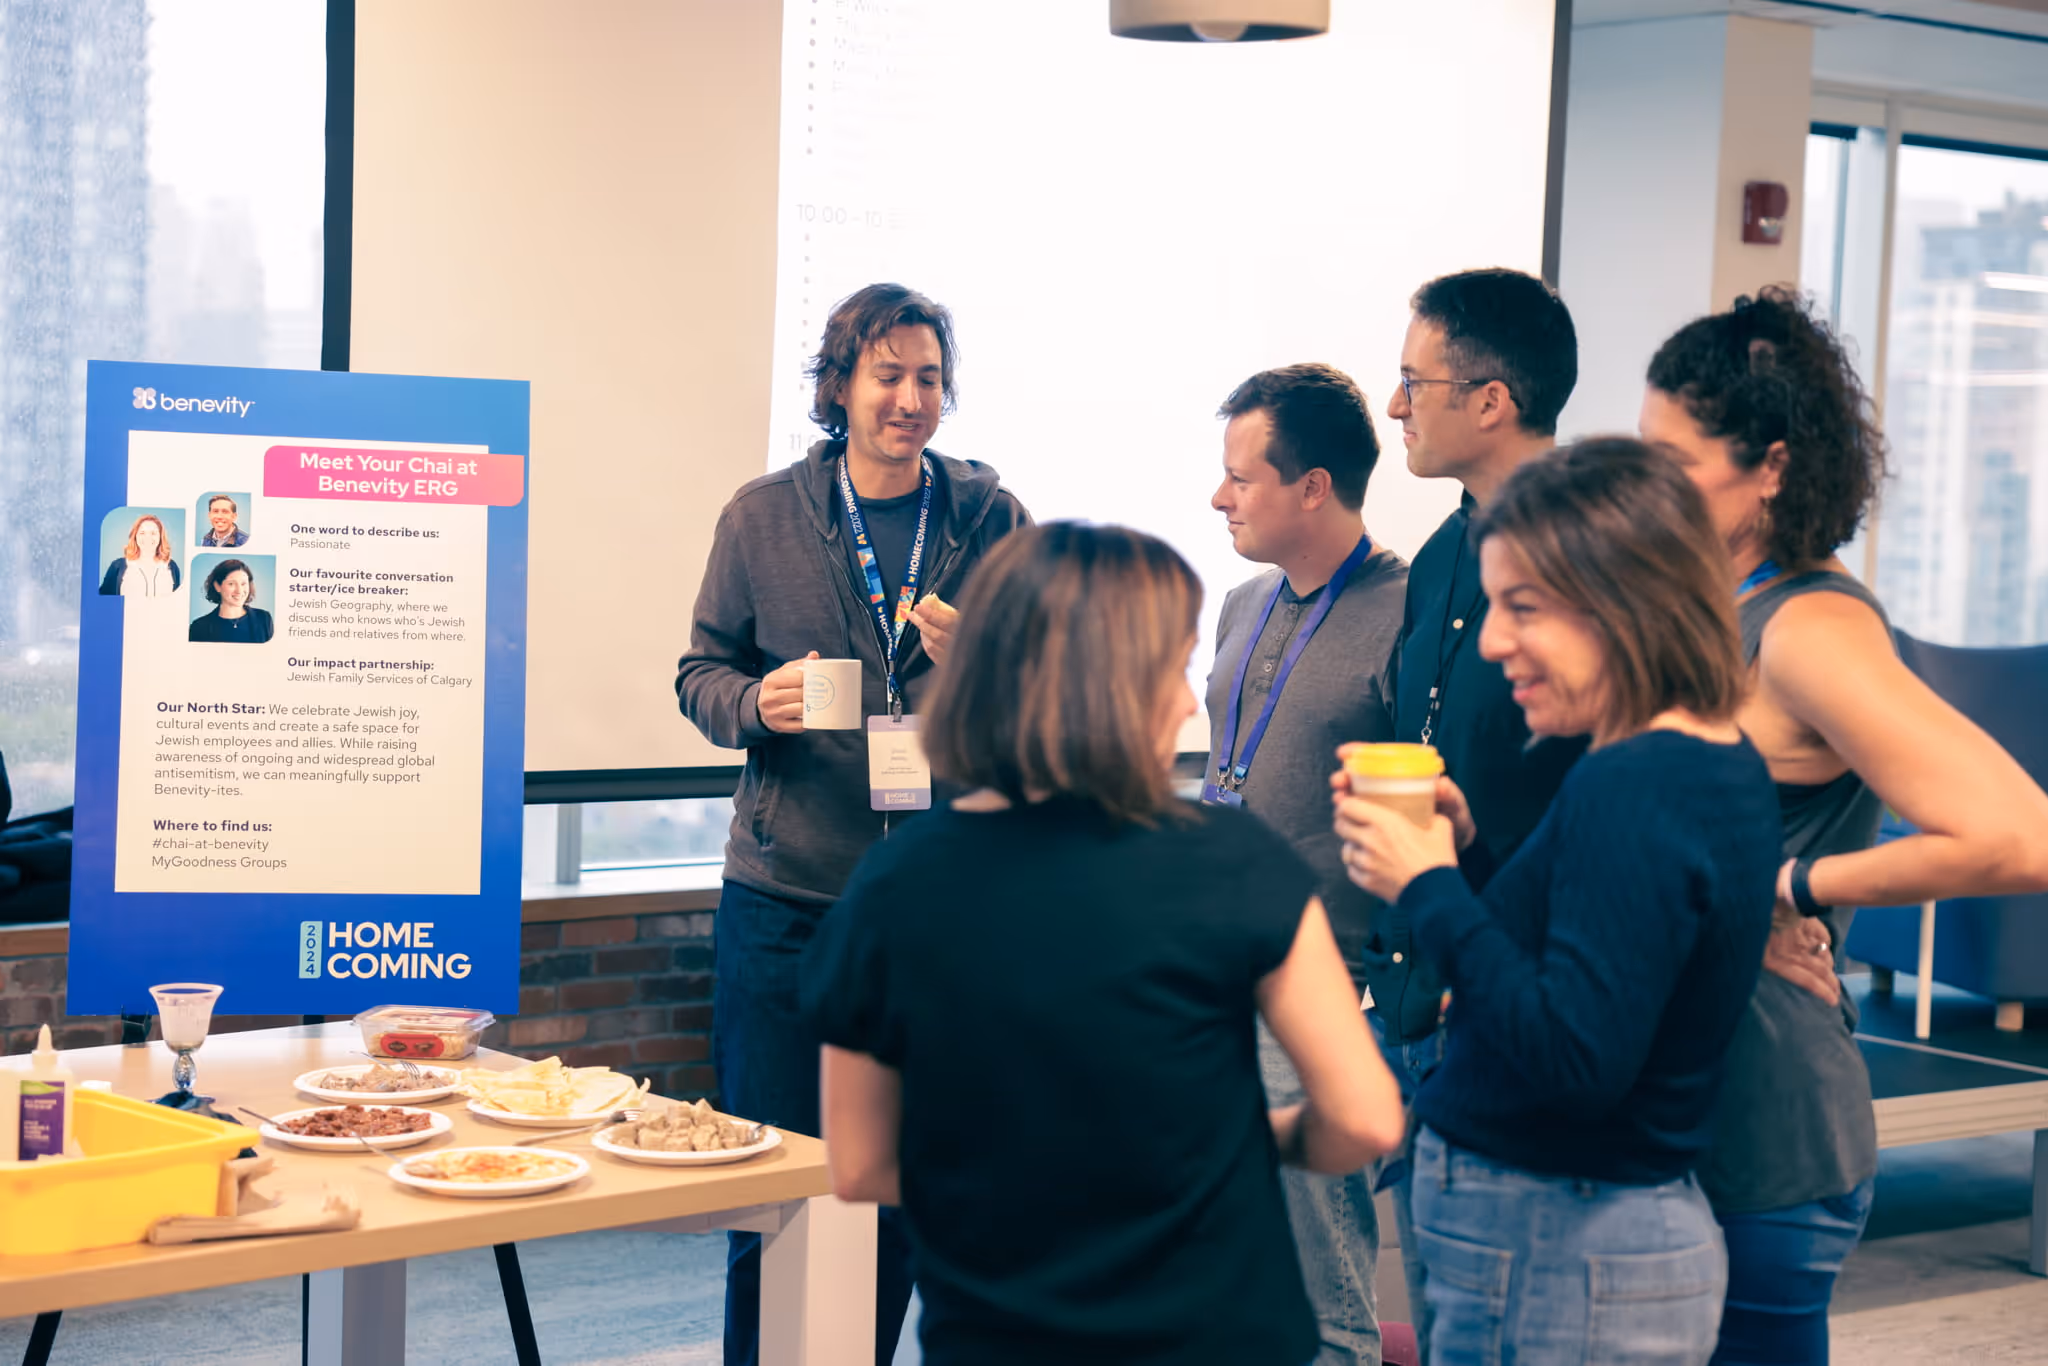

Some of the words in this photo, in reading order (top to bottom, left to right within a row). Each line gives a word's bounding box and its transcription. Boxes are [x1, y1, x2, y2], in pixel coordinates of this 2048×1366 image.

[160, 393, 250, 418] benevity
[300, 452, 354, 471] Meet
[357, 455, 405, 473] Your
[408, 457, 453, 475] Chai
[456, 459, 478, 476] at
[319, 475, 410, 497] Benevity
[414, 479, 459, 497] ERG
[290, 524, 316, 534] One
[318, 525, 349, 535] word
[351, 526, 365, 536] to
[367, 526, 420, 538] describe
[422, 530, 439, 539] us:
[850, 513, 864, 535] 2022
[908, 509, 929, 575] HOMECOMING
[922, 488, 932, 511] 2022
[290, 537, 351, 549] Passionate
[289, 568, 313, 578] Our
[315, 568, 373, 580] favourite
[375, 572, 454, 583] conversation
[289, 583, 355, 594] starter/ice
[358, 584, 409, 596] breaker:
[288, 598, 328, 609] Jewish
[330, 599, 394, 614] Geography,
[397, 601, 431, 613] where
[432, 604, 448, 613] we
[288, 612, 329, 624] discuss
[331, 613, 355, 624] who
[357, 614, 392, 625] knows
[394, 615, 425, 626] who's
[427, 616, 465, 628] Jewish
[288, 627, 328, 638] friends
[329, 628, 351, 640] and
[353, 628, 400, 640] relatives
[402, 629, 428, 641] from
[430, 631, 466, 642] where.
[287, 657, 311, 667] Our
[313, 657, 357, 670] impact
[359, 659, 434, 673] partnership:
[287, 672, 326, 682] Jewish
[328, 672, 365, 684] Family
[366, 673, 414, 685] Services
[416, 674, 429, 685] of
[430, 674, 473, 688] Calgary
[157, 701, 184, 713] Our
[187, 702, 229, 714] North
[232, 703, 266, 715] Star:
[269, 704, 289, 715] We
[292, 705, 351, 716] celebrate
[353, 706, 396, 717] Jewish
[399, 707, 420, 721] joy,
[156, 717, 204, 730] cultural
[207, 720, 250, 731] events
[252, 719, 276, 732] and
[279, 721, 319, 733] create
[322, 724, 330, 733] a
[332, 721, 360, 733] safe
[362, 724, 399, 736] space
[401, 722, 420, 736] for
[155, 734, 200, 746] Jewish
[203, 736, 273, 750] employees
[275, 736, 299, 748] and
[302, 736, 336, 749] allies.
[340, 737, 374, 749] While
[377, 738, 417, 753] raising
[155, 753, 223, 763] awareness
[225, 751, 239, 763] of
[241, 752, 294, 767] ongoing
[296, 753, 320, 765] and
[323, 753, 394, 768] widespread
[397, 754, 435, 769] global
[154, 767, 239, 781] antisemitism,
[242, 771, 261, 780] we
[263, 771, 286, 781] can
[289, 769, 370, 785] meaningfully
[372, 772, 421, 785] support
[154, 783, 243, 799] Benevity-ites.
[153, 819, 199, 831] Where
[202, 820, 218, 832] to
[220, 819, 249, 832] find
[253, 823, 272, 832] us:
[152, 837, 270, 853] #chai-at-benevity
[151, 855, 237, 869] MyGoodness
[240, 856, 287, 870] Groups
[329, 921, 435, 948] HOME
[305, 925, 316, 975] 2024
[327, 952, 472, 980] COMING
